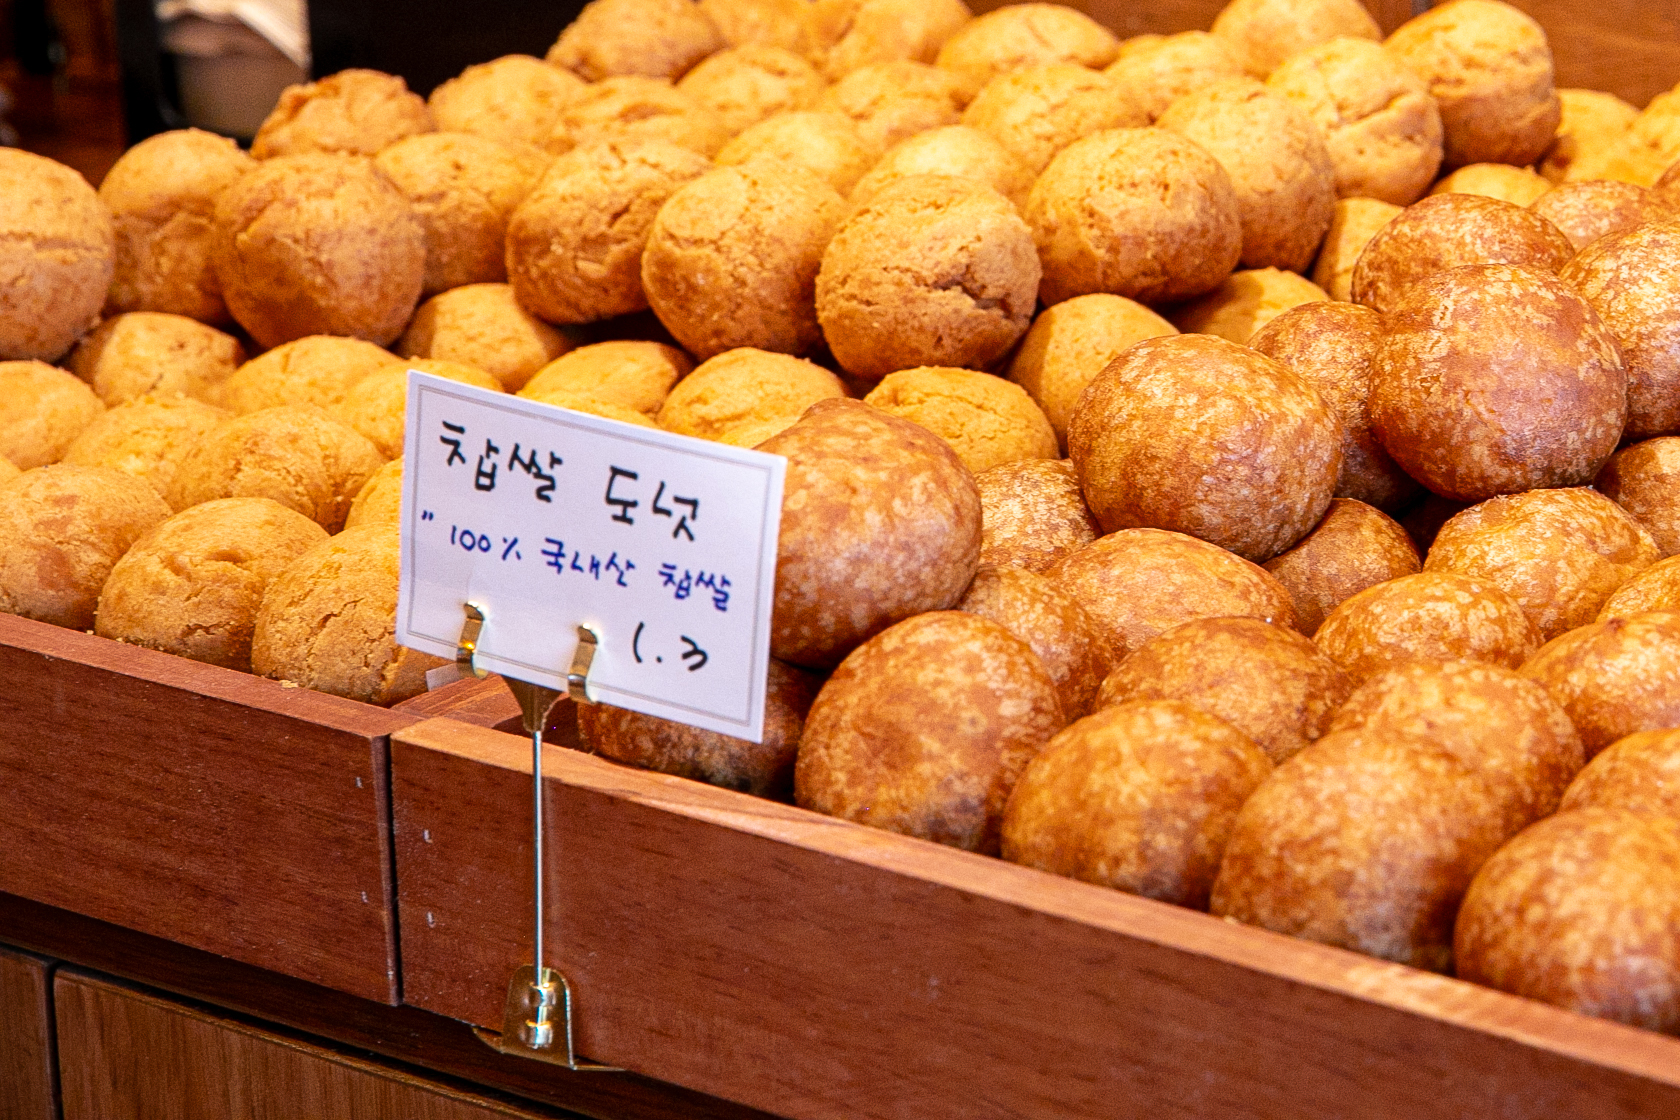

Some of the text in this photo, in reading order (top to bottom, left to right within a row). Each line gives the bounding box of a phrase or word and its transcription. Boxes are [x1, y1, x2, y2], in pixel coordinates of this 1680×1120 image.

[440, 421, 699, 542] 찹쌀 도넛
[540, 536, 636, 588] 국내산
[658, 563, 732, 612] 찹쌀
